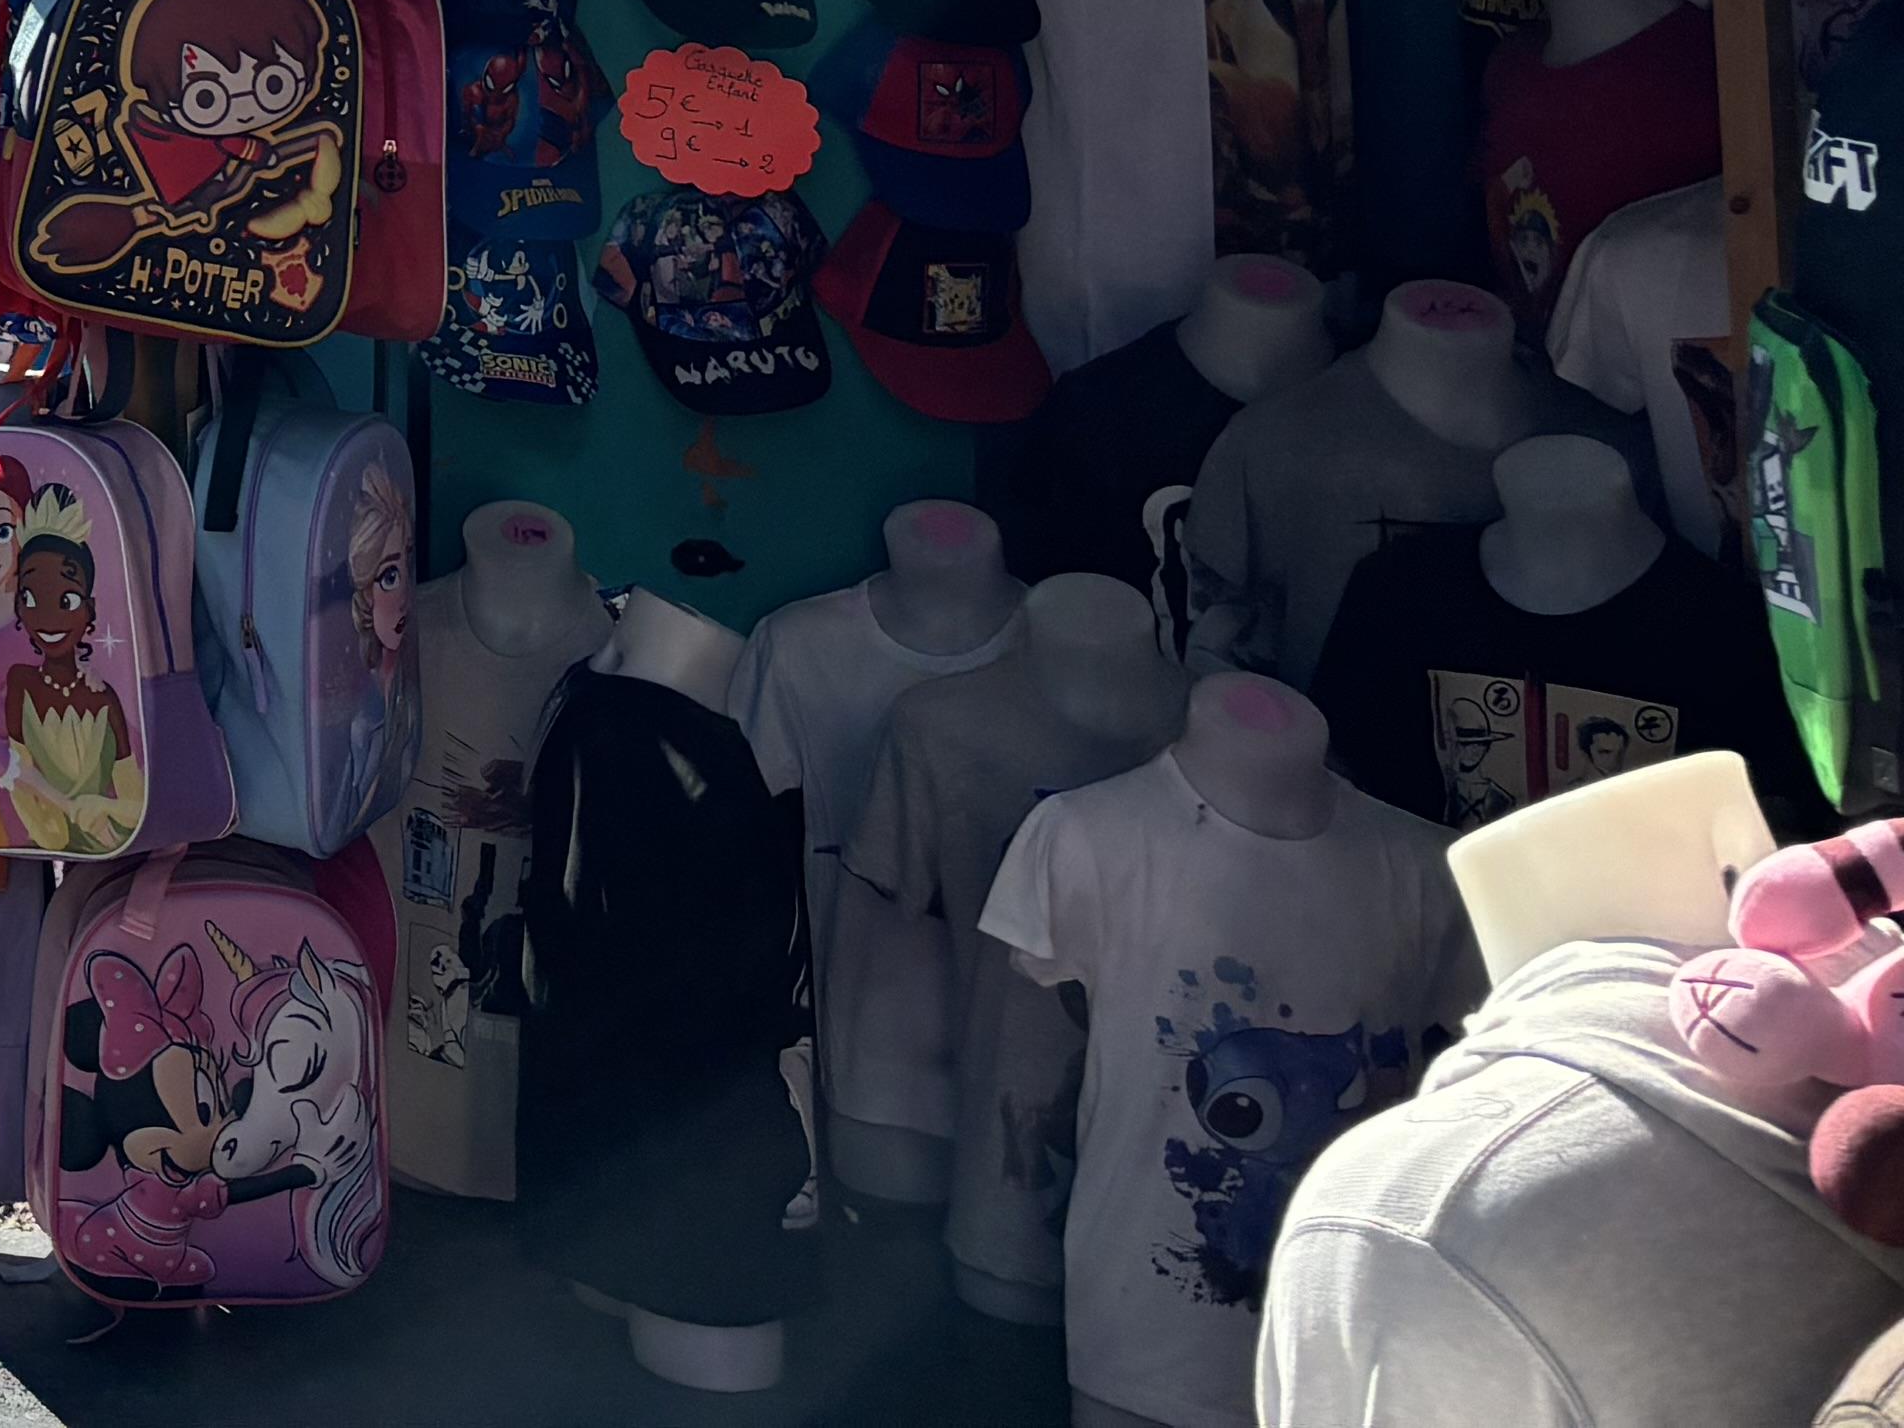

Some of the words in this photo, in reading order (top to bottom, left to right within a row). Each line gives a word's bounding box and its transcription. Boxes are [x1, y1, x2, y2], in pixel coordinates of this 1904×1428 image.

[685, 51, 763, 88] Casquette
[707, 77, 760, 103] Enfant
[758, 154, 775, 174] 2
[165, 246, 264, 311] POTTER
[482, 354, 552, 376] SONIC
[674, 345, 820, 385] NARUTO
